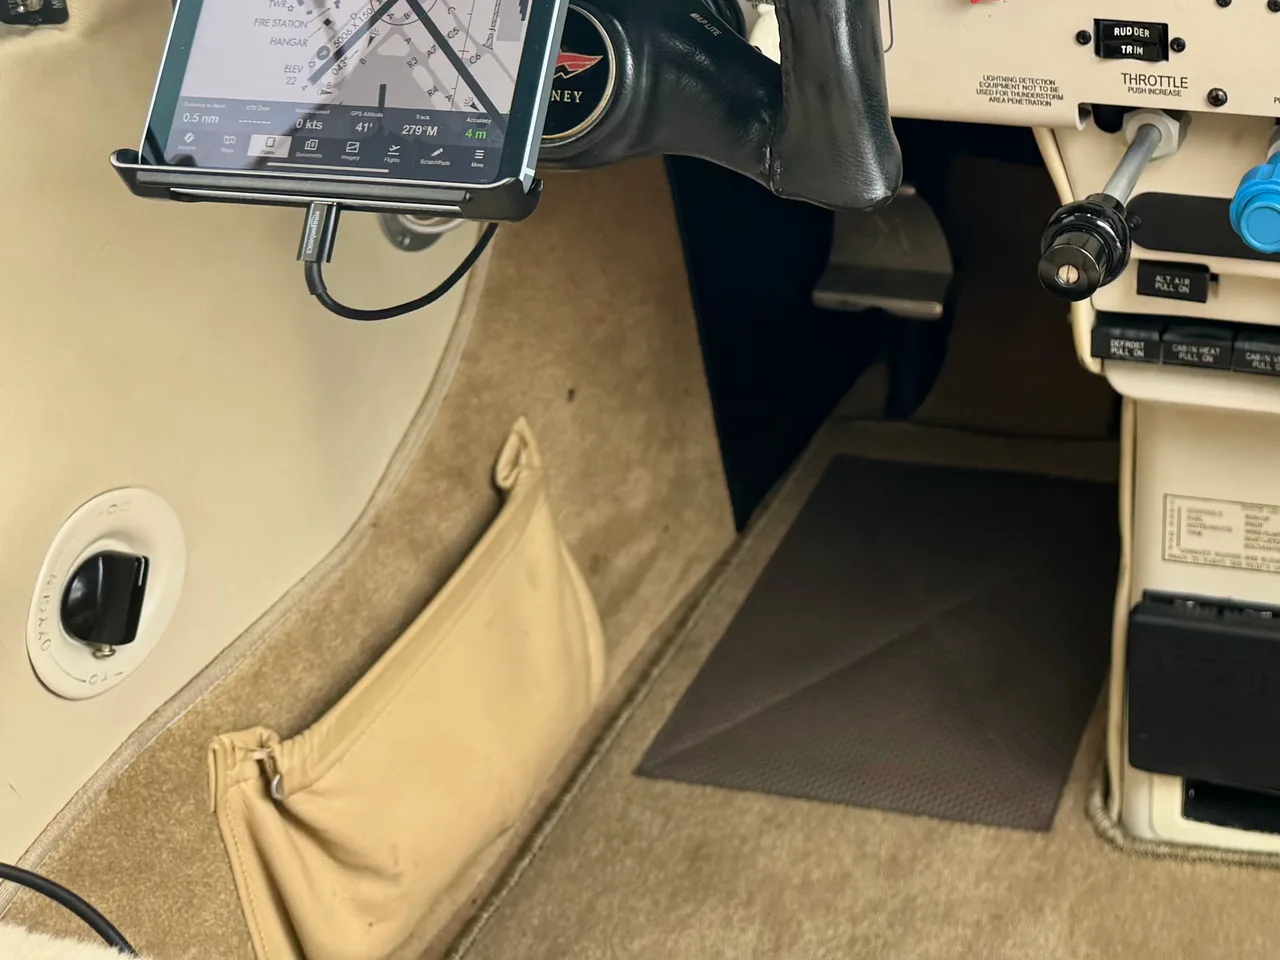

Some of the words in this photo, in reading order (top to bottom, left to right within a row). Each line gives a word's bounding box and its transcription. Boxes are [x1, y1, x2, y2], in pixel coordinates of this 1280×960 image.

[1114, 27, 1150, 38] RUDDER
[270, 37, 308, 47] HANGAR
[1121, 45, 1144, 55] TRIM
[1121, 73, 1188, 89] THROTTLE
[1128, 87, 1146, 95] PUSH
[1148, 88, 1182, 97] INCREASE
[182, 113, 200, 124] 0.5
[202, 115, 219, 124] nm
[1155, 274, 1170, 284] ALT
[1172, 277, 1190, 285] AIR
